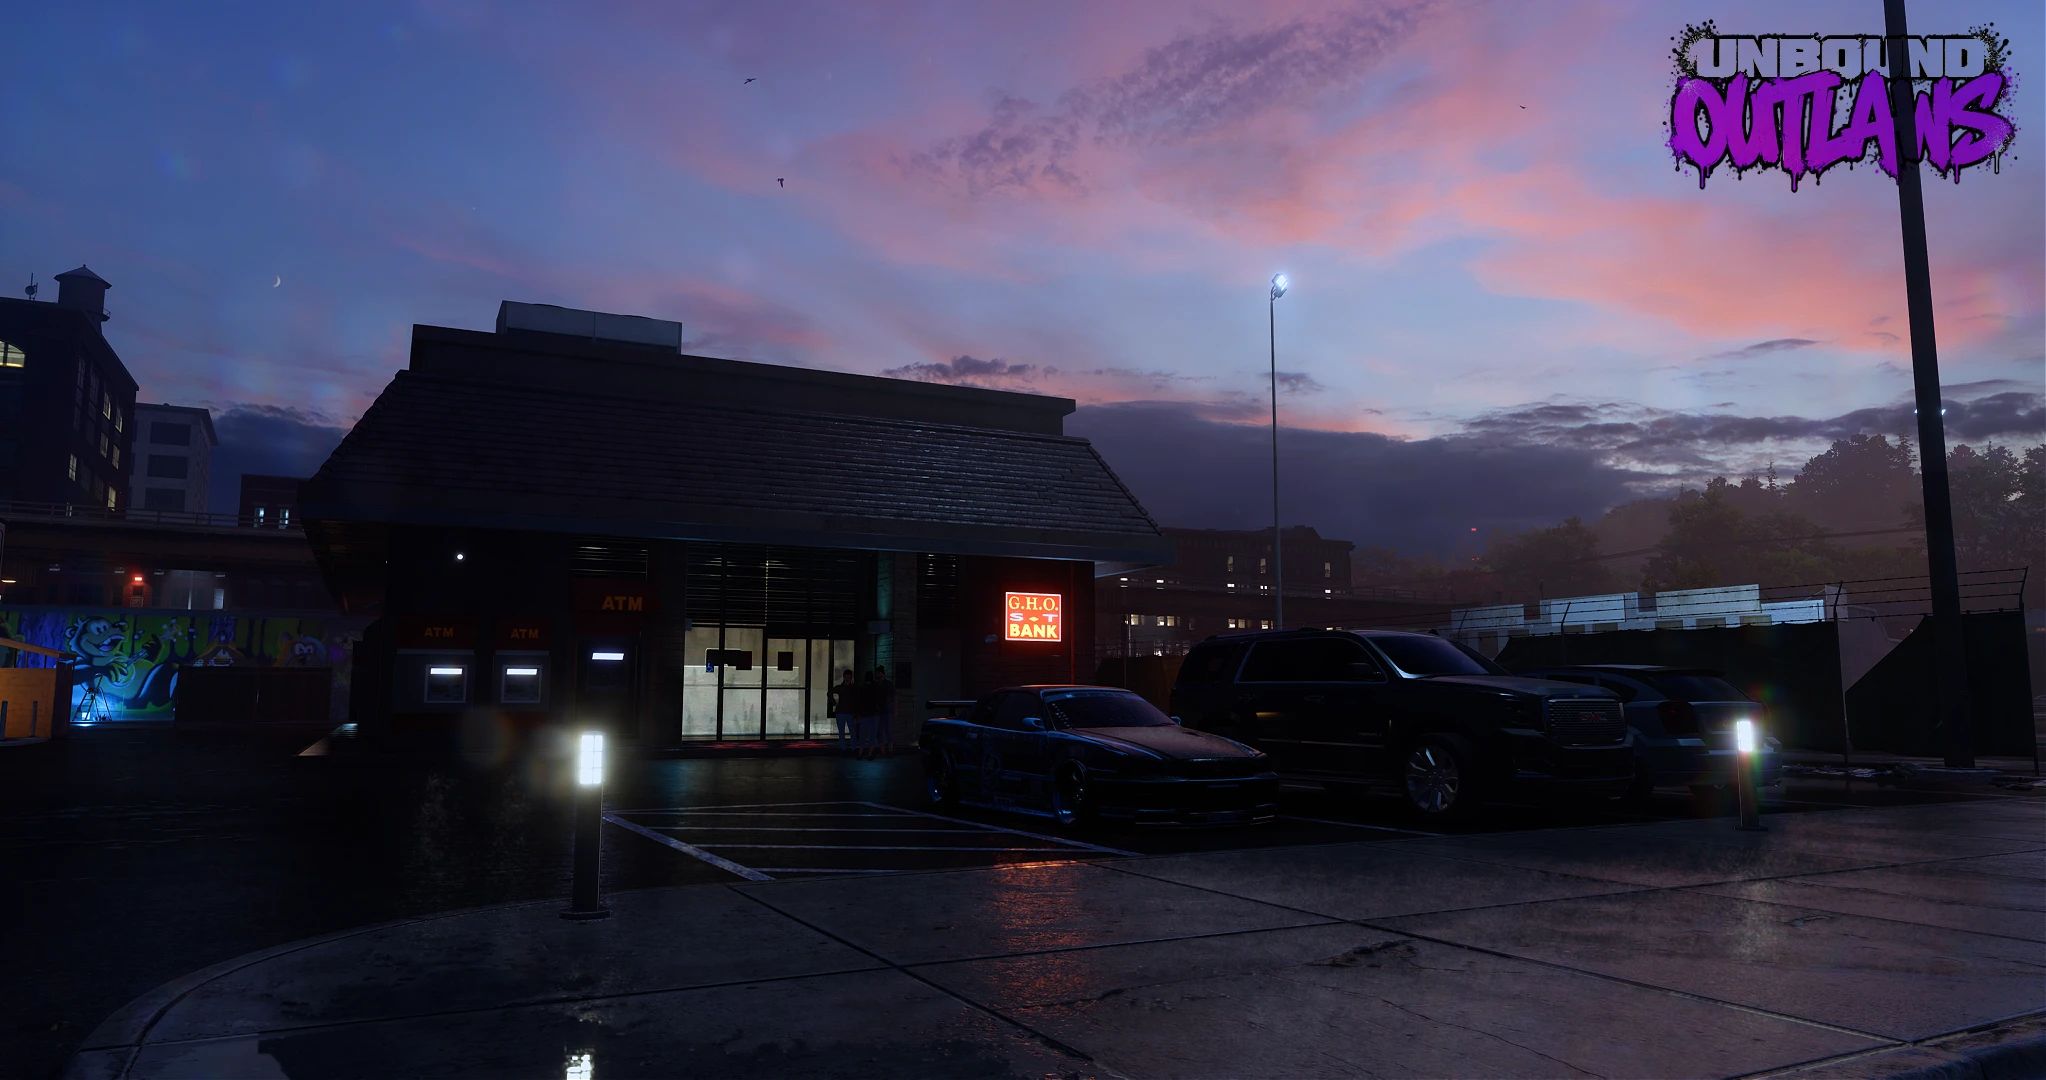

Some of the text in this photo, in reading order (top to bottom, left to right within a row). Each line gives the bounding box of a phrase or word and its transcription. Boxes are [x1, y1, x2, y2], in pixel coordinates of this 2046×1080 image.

[602, 596, 643, 611] ATM
[1008, 596, 1059, 611] G.H.O.
[424, 627, 455, 638] ATM
[510, 628, 539, 639] ATM
[1009, 623, 1058, 638] BANK
